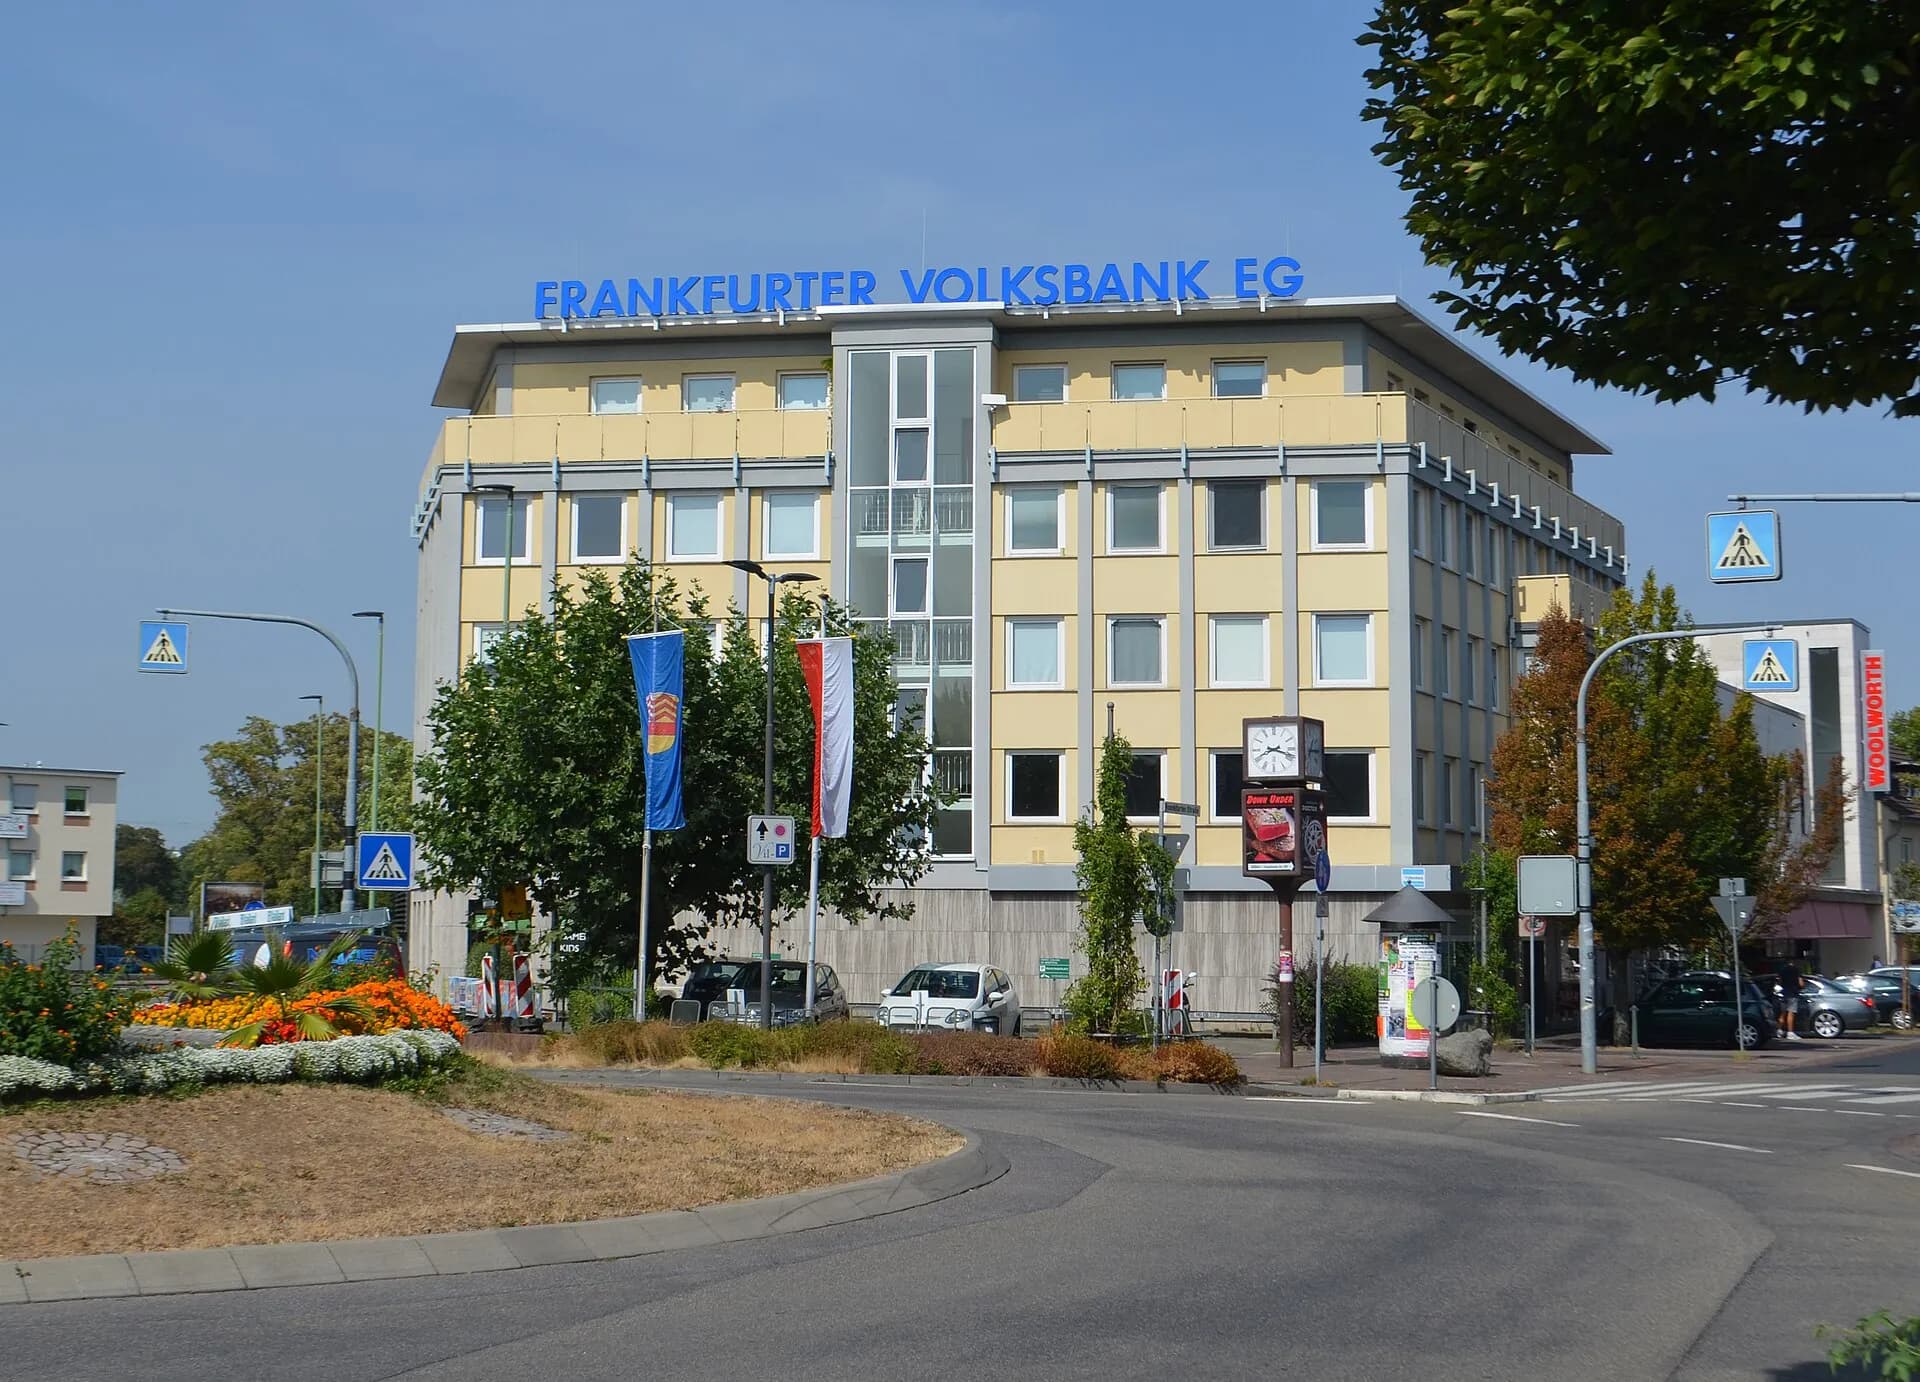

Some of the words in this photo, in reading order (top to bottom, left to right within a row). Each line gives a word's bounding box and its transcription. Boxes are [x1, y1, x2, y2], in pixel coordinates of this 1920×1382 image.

[535, 271, 876, 320] FRANKFURTER
[900, 258, 1210, 305] VOLKSBANK
[1235, 256, 1305, 298] EG
[1865, 656, 1886, 788] WOOLWORTH
[559, 944, 580, 952] KIDS
